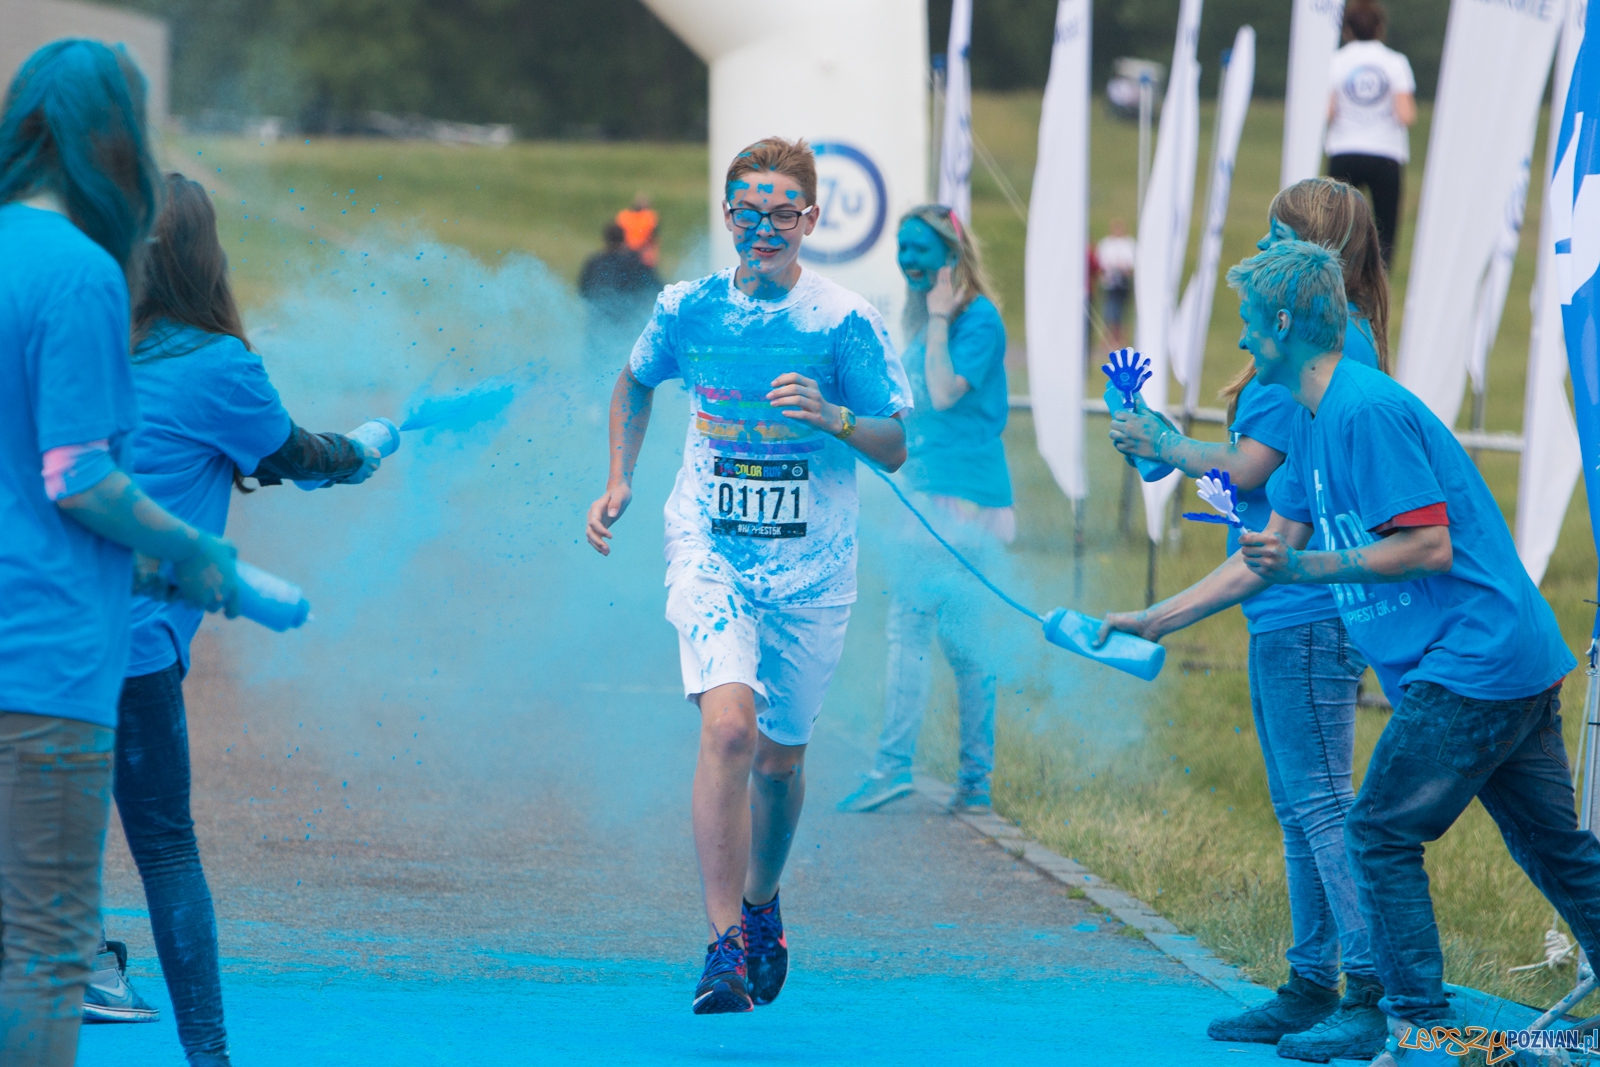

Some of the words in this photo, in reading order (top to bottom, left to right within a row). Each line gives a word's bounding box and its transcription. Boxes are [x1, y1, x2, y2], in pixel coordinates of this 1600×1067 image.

[735, 463, 762, 477] COLOR
[718, 483, 800, 520] 01171
[1342, 605, 1375, 626] PIEST
